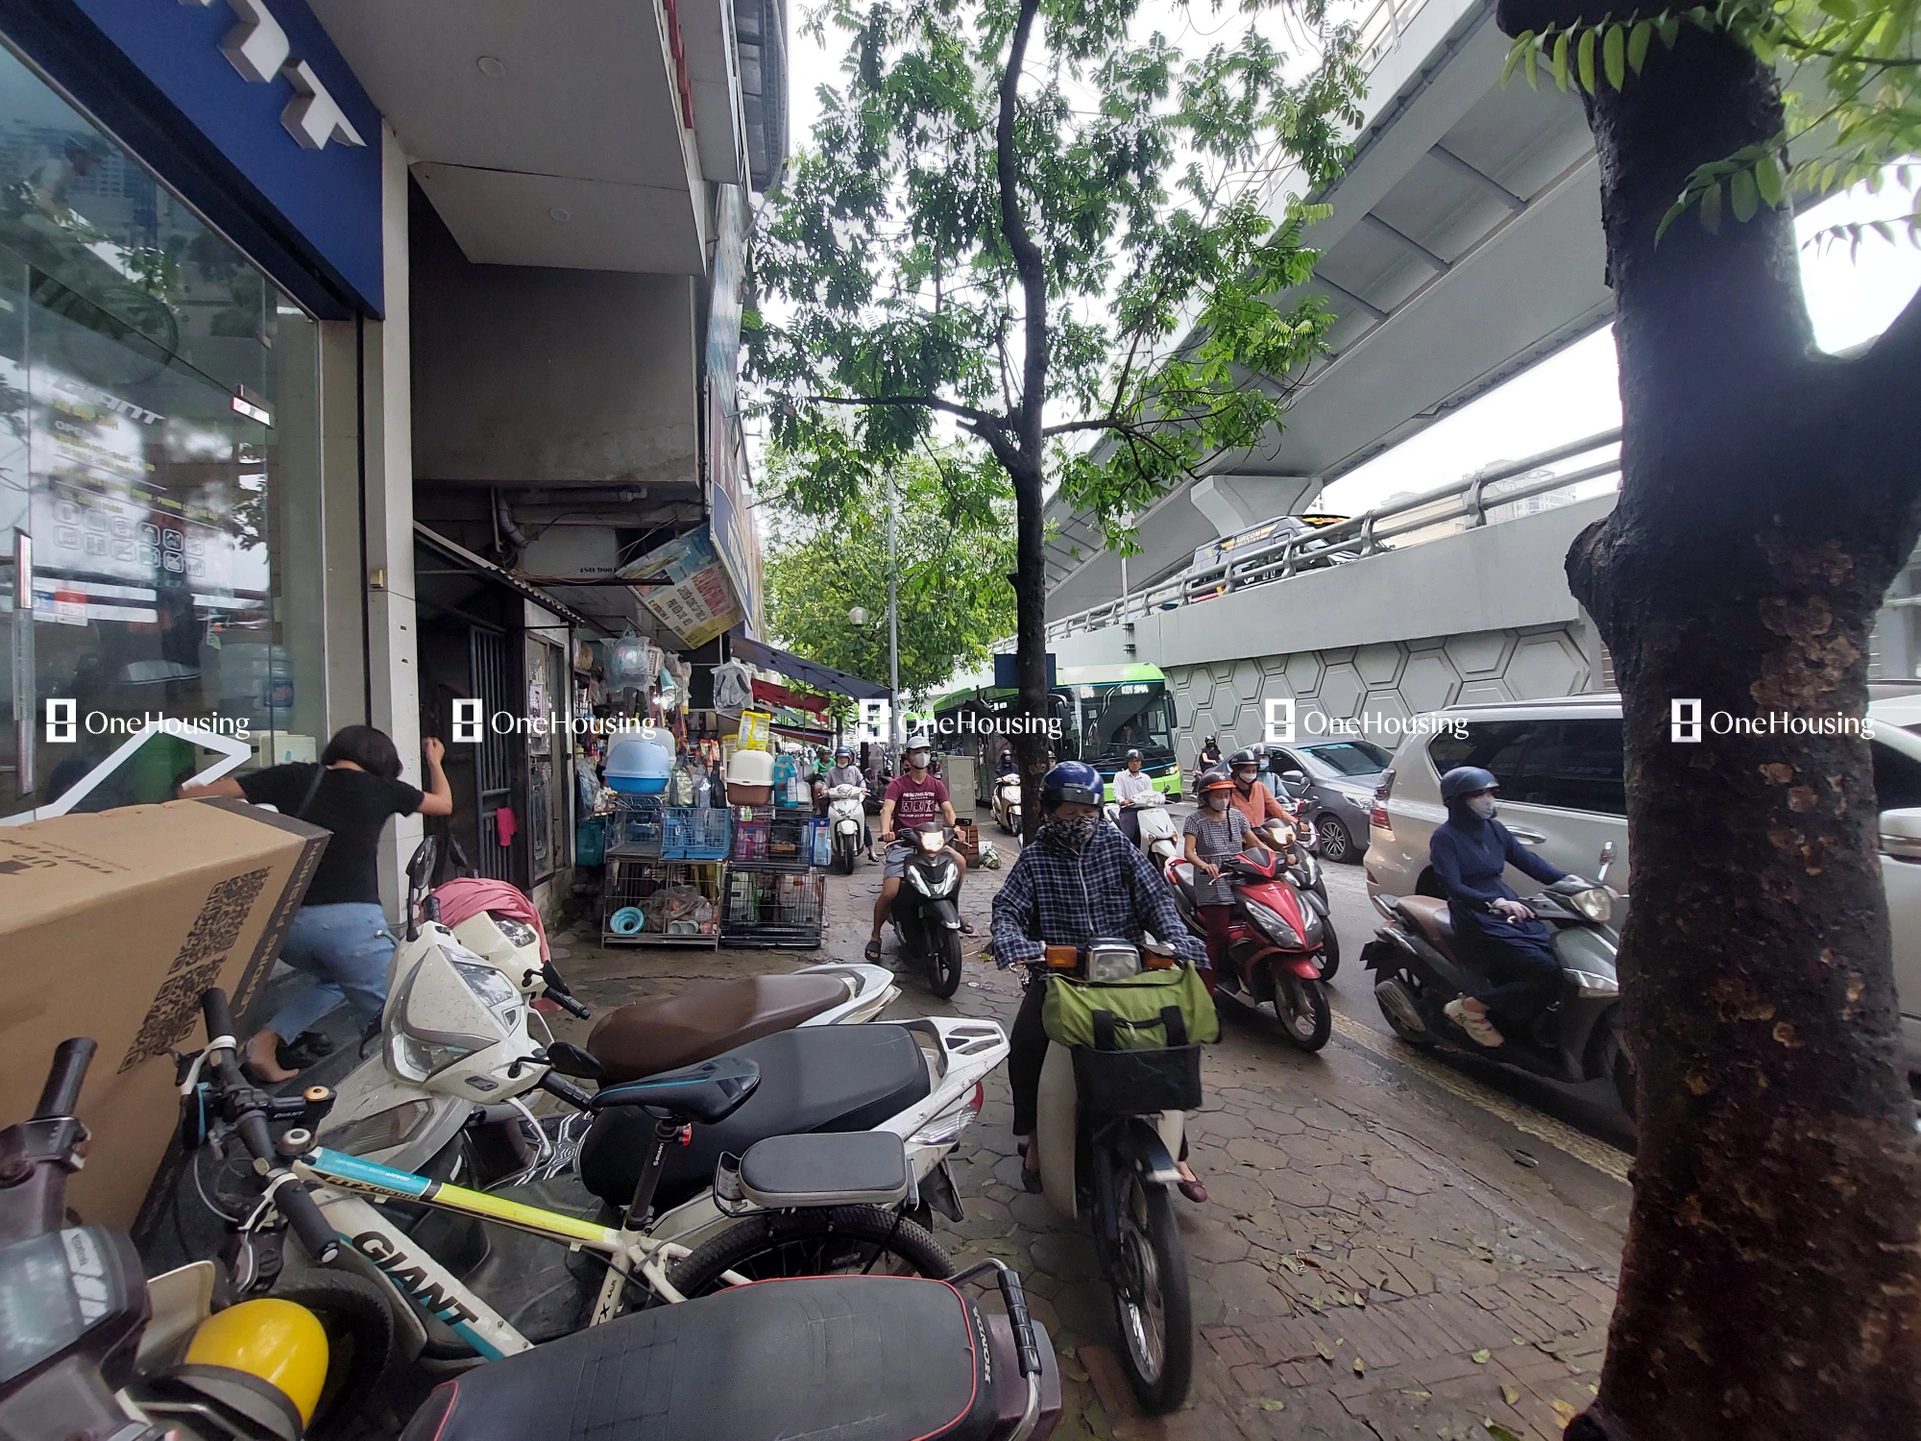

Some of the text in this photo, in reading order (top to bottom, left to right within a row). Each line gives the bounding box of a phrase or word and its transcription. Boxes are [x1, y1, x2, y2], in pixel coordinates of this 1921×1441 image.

[12, 854, 58, 868] UP
[234, 841, 322, 1019] LEADING FASHION
[273, 1110, 304, 1119] GIANT
[352, 1230, 479, 1327] GIANT
[972, 1305, 991, 1385] HONDA
